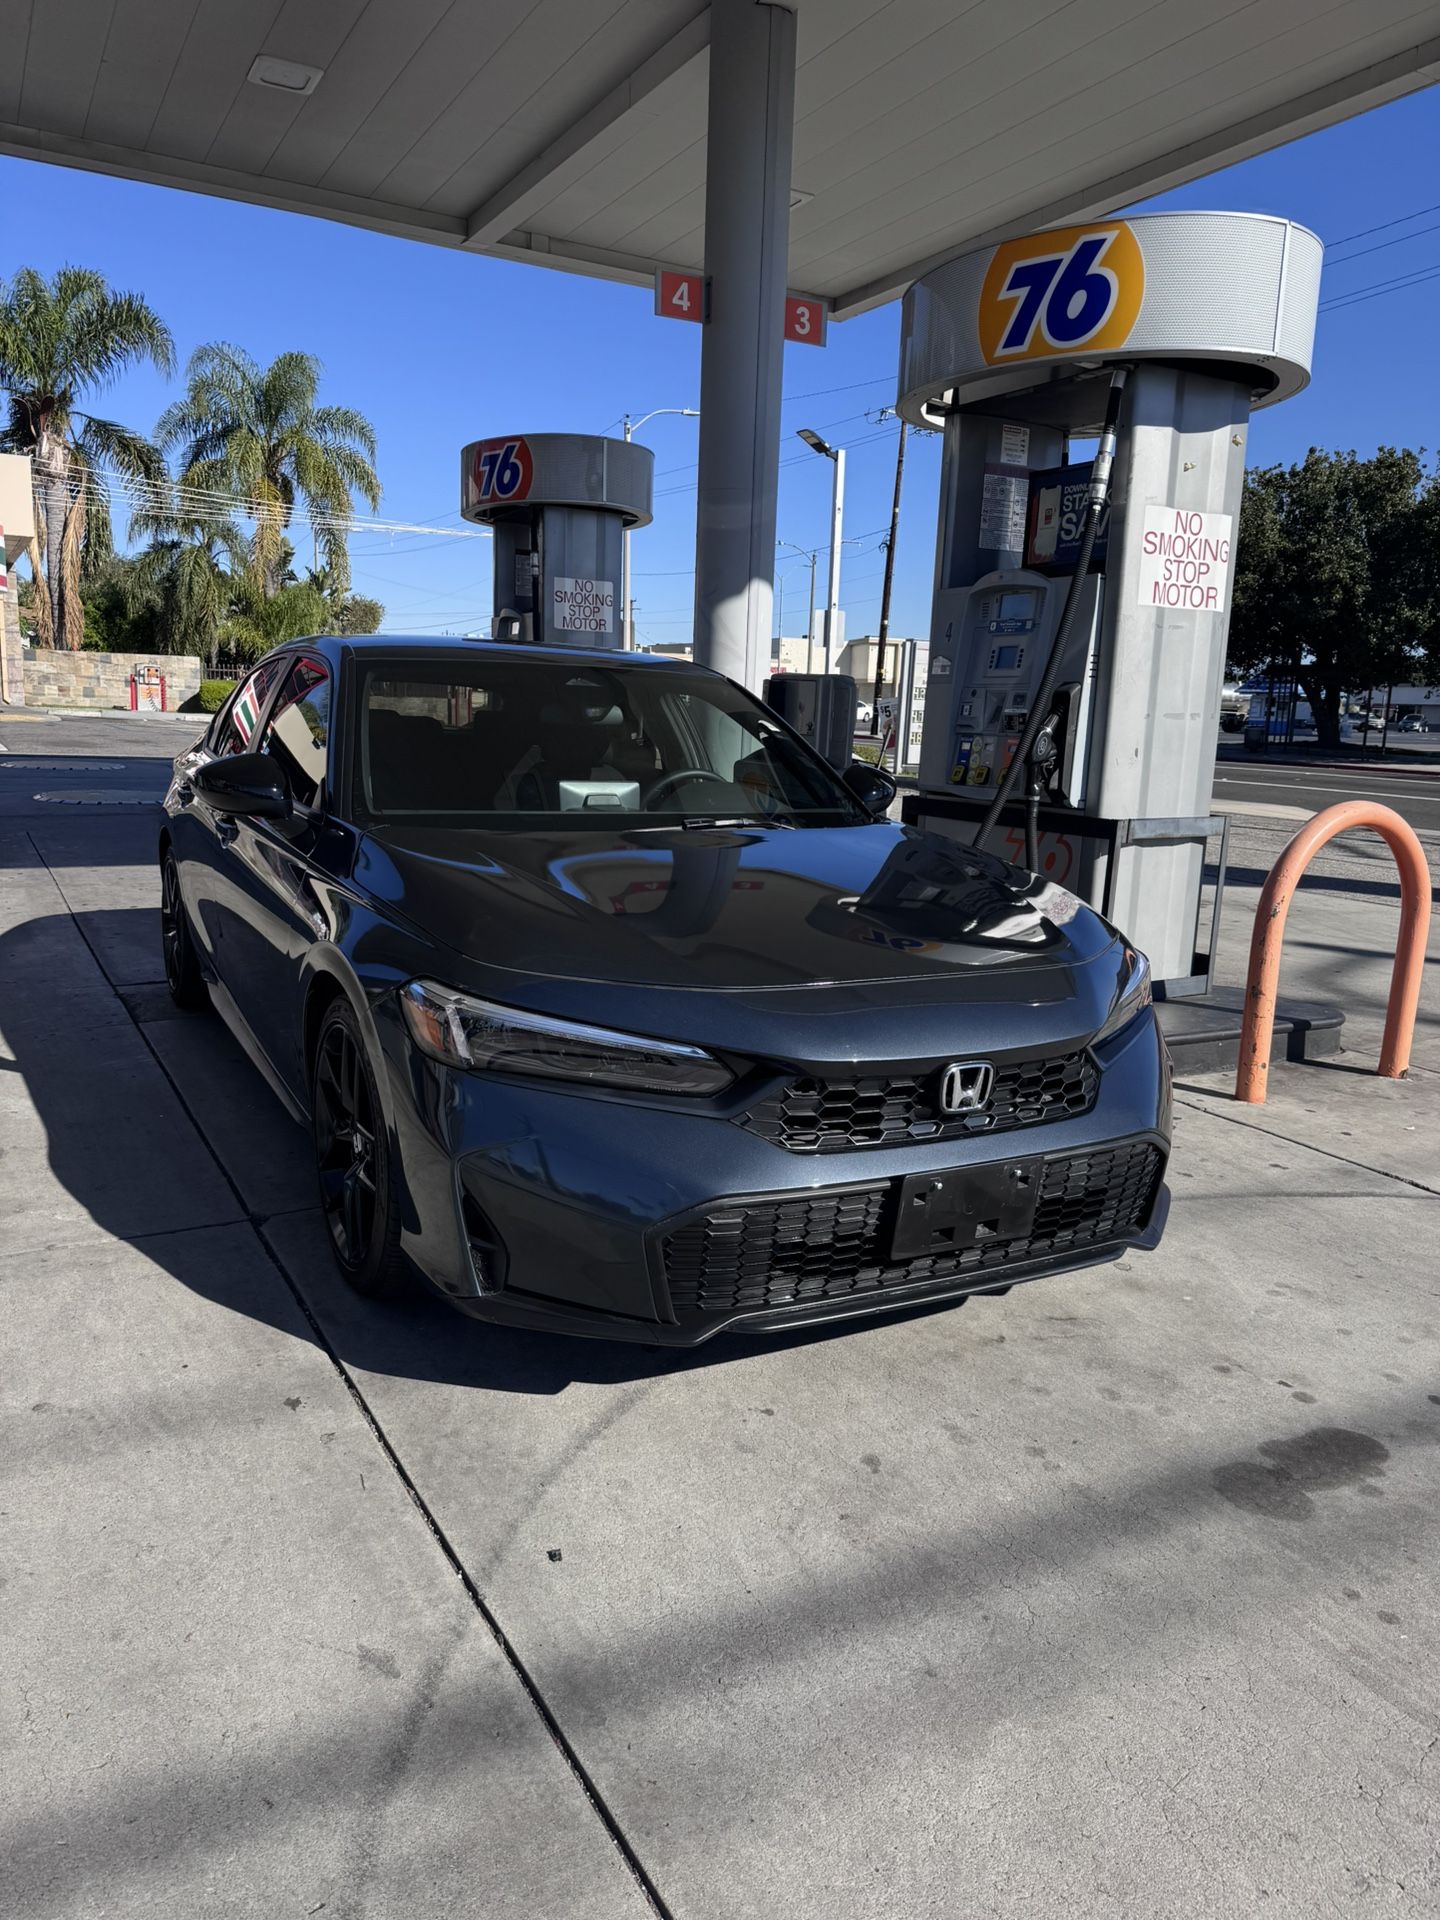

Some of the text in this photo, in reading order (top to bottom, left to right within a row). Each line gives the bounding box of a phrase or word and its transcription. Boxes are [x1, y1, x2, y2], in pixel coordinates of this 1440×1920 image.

[672, 282, 691, 311] 4
[994, 230, 1120, 357] 76
[794, 306, 811, 335] 3
[480, 441, 522, 498] 76
[1063, 488, 1113, 511] STAK
[1061, 507, 1112, 541] SAV
[1175, 511, 1203, 536] NO
[1143, 531, 1229, 563] SMOKING
[1163, 558, 1210, 584] STOP
[554, 590, 613, 607] SMOKING
[574, 579, 594, 593] NO
[1152, 581, 1218, 609] MOTOR
[562, 616, 607, 631] MOTOR
[568, 604, 600, 618] STOP
[945, 621, 953, 643] 4
[880, 705, 892, 718] $5
